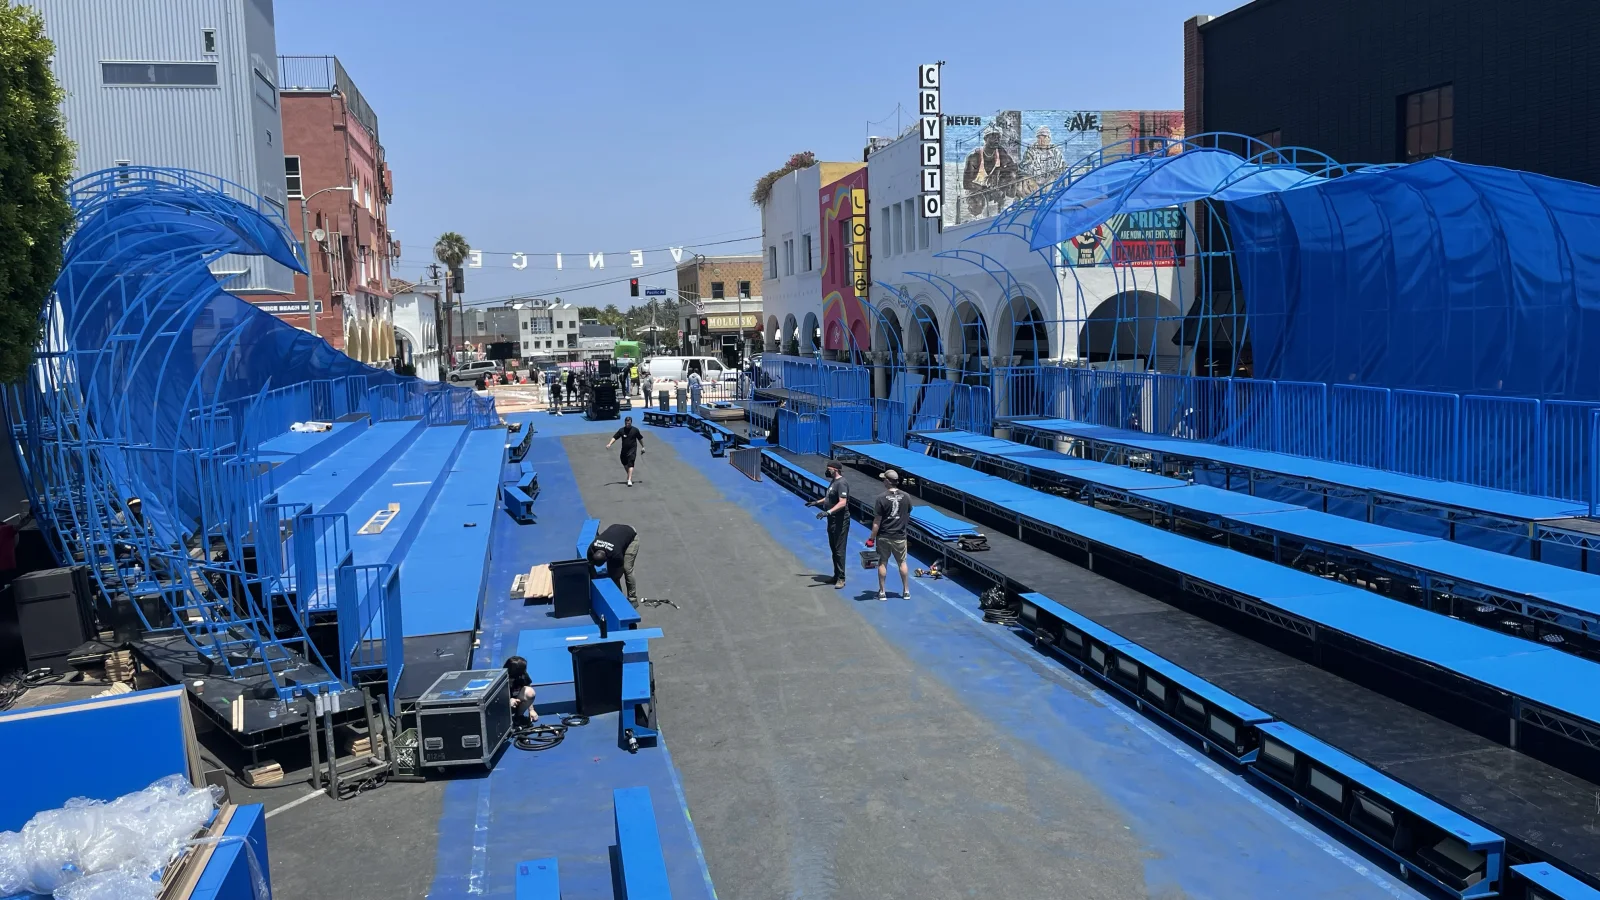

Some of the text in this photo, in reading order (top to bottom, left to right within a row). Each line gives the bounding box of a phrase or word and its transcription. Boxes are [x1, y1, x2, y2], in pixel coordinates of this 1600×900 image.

[946, 116, 982, 126] NEVER
[925, 66, 939, 214] CRYPTO
[1130, 211, 1181, 228] PRICES
[709, 316, 753, 327] MOLLUSK
